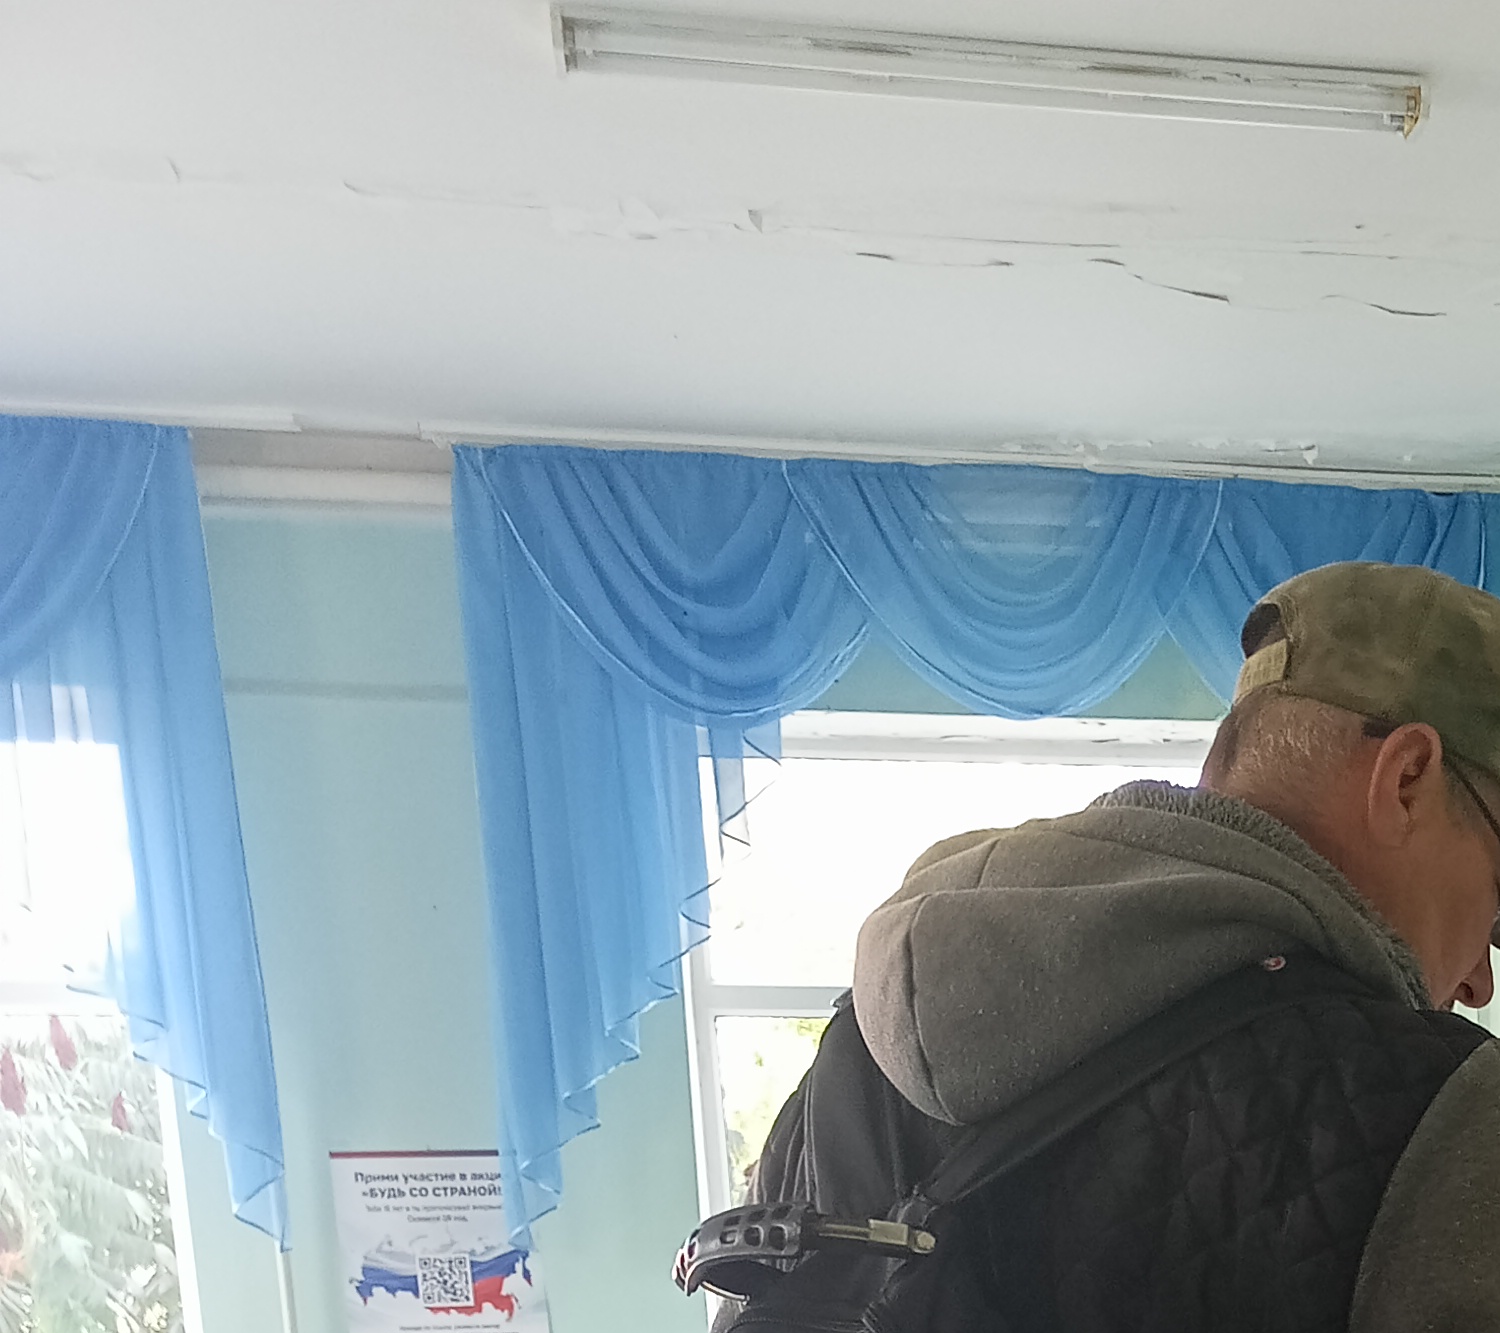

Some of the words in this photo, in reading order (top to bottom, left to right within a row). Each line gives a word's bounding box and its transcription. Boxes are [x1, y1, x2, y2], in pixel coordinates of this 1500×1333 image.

[354, 1171, 399, 1184] Прими
[402, 1171, 456, 1184] участие
[470, 1171, 502, 1183] акци
[409, 1186, 429, 1198] СО
[432, 1183, 503, 1198] СТРАНОЙ!
